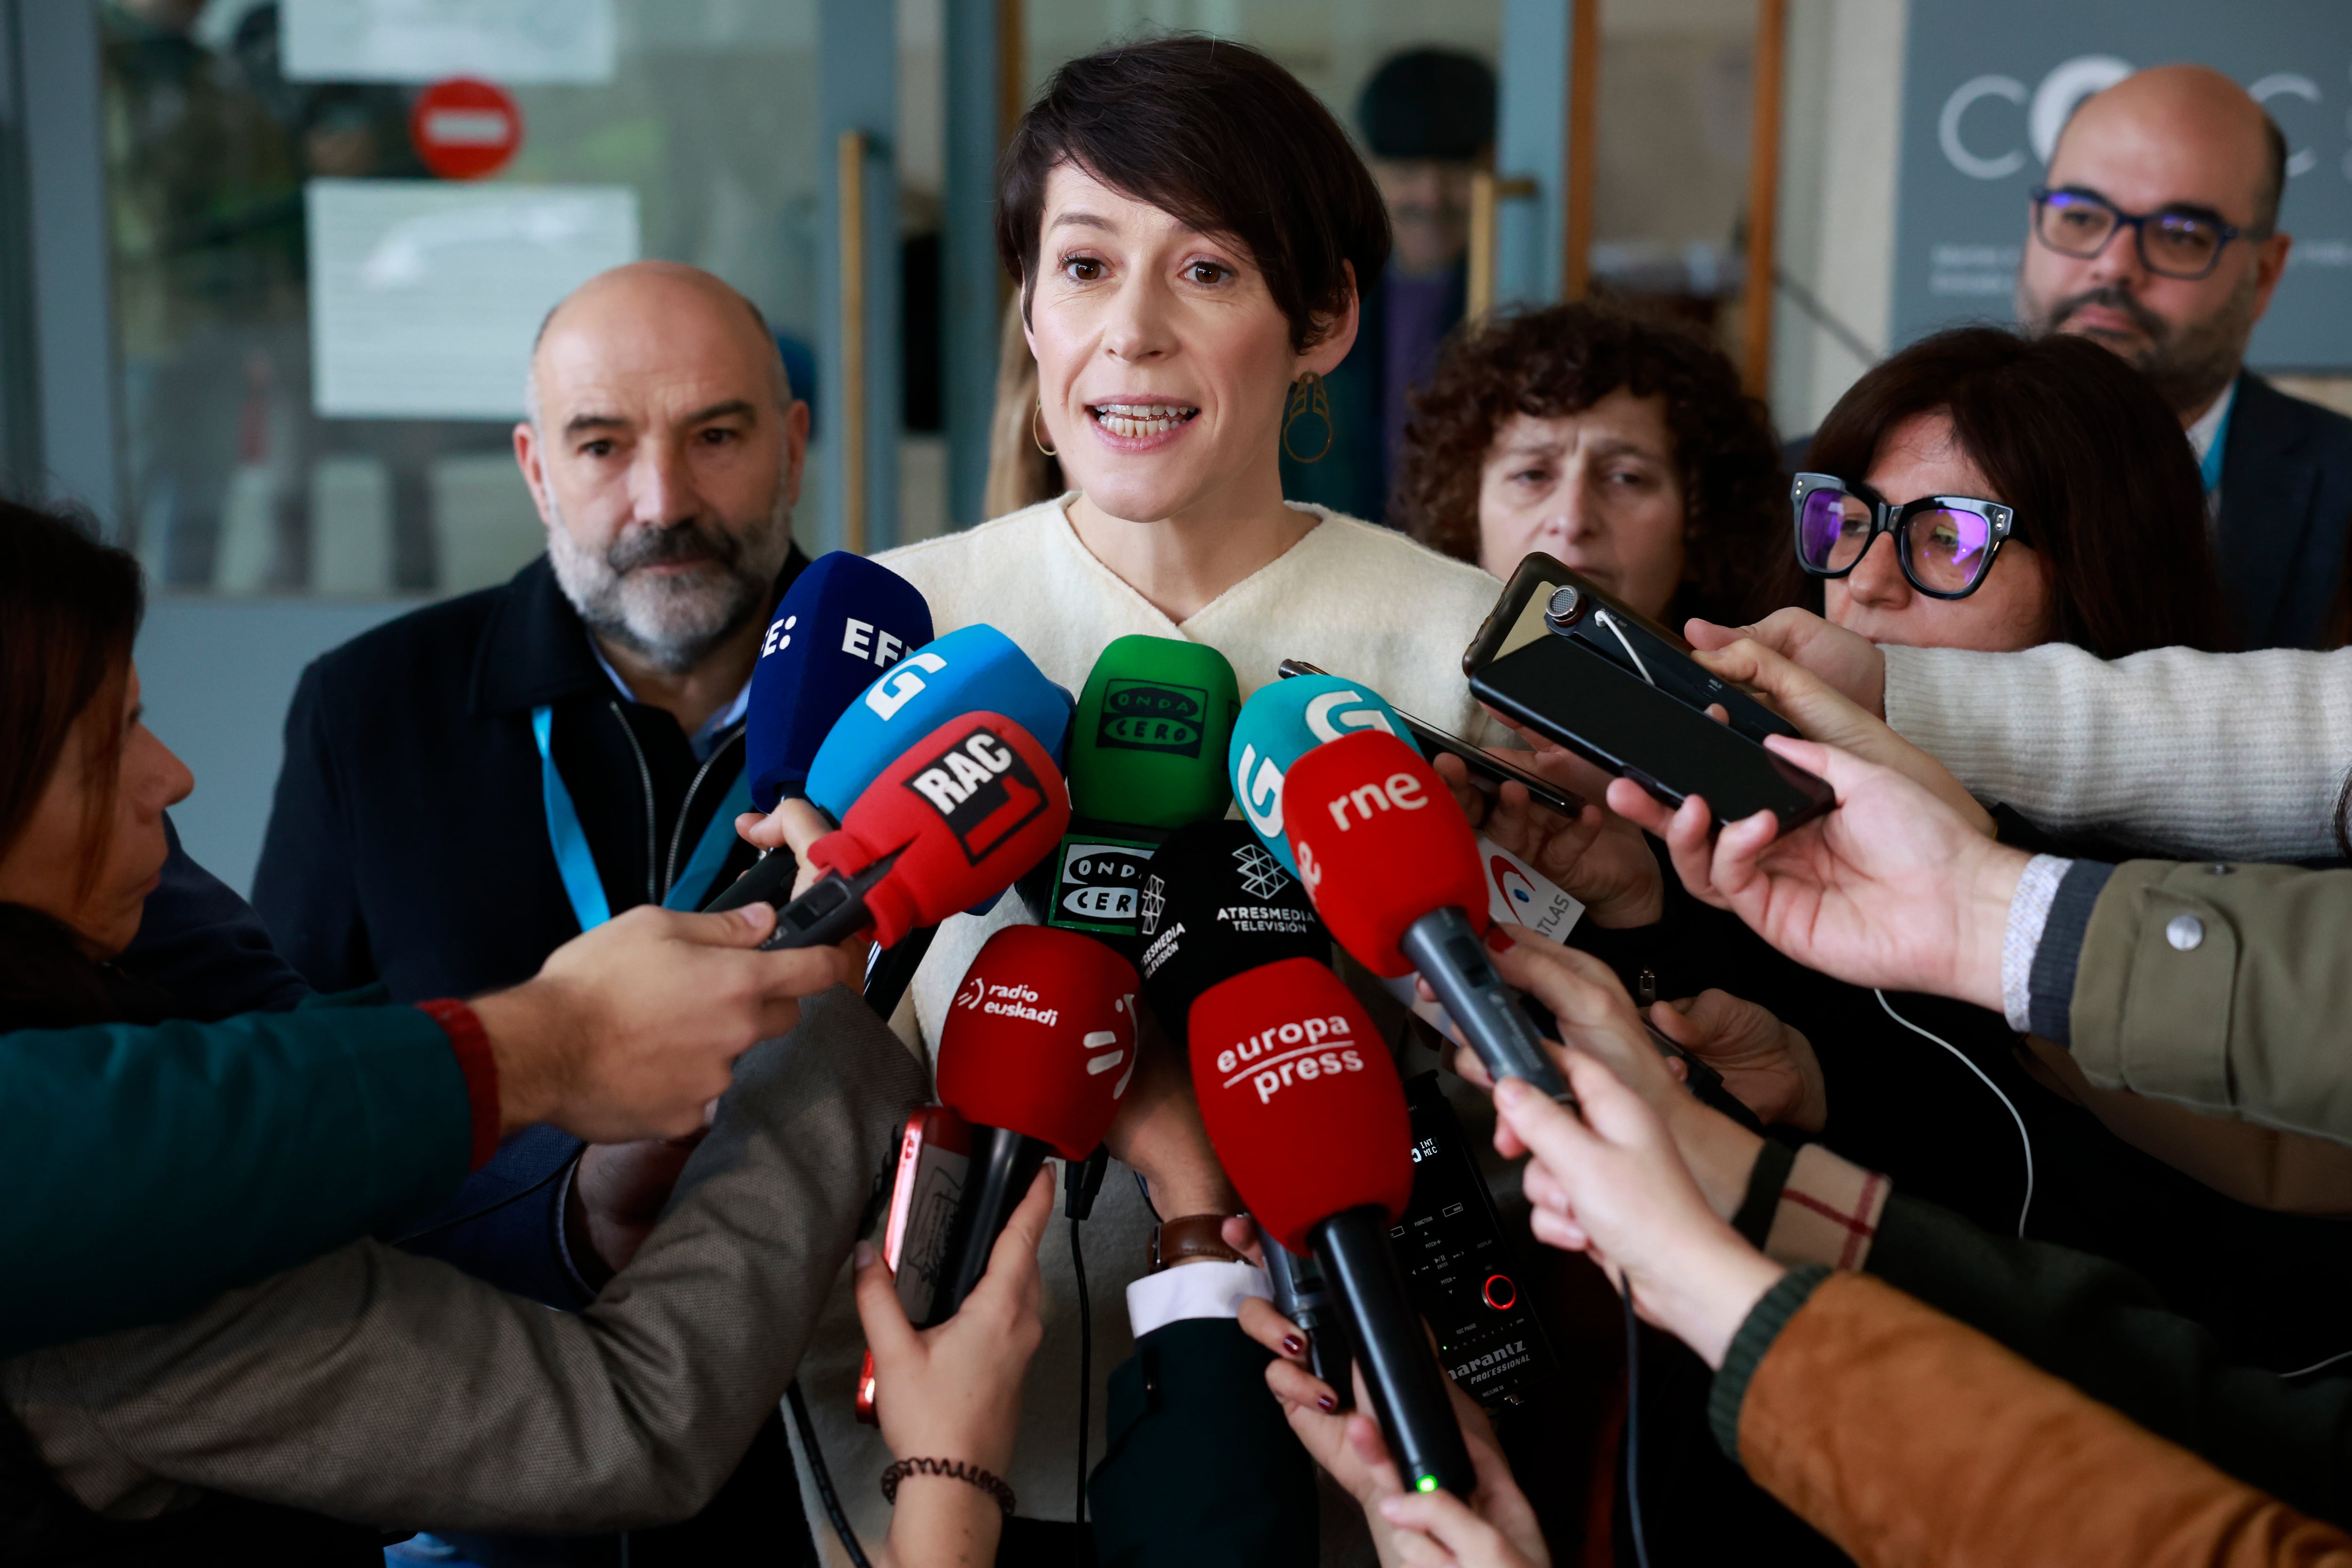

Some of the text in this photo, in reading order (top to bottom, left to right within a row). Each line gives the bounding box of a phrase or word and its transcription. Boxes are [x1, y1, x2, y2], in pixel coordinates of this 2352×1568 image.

[842, 617, 915, 668] EF
[1117, 692, 1192, 712] ONDA
[1115, 720, 1188, 743] CERO
[912, 733, 1013, 816] RAC
[1328, 772, 1429, 832] rne
[1078, 859, 1144, 880] OND
[1077, 891, 1132, 912] CER
[1216, 907, 1316, 923] ATRESMEDIA
[1232, 920, 1307, 934] TELEVISIÓN
[989, 982, 1040, 1003] radio
[984, 999, 1058, 1027] euskadi
[1216, 1015, 1351, 1073] europa
[1253, 1045, 1364, 1105] press
[1420, 1138, 1433, 1149] INT
[1424, 1146, 1437, 1157] MIC
[1414, 1217, 1433, 1227] FUNCTION
[1478, 1239, 1492, 1249] DISPLAY
